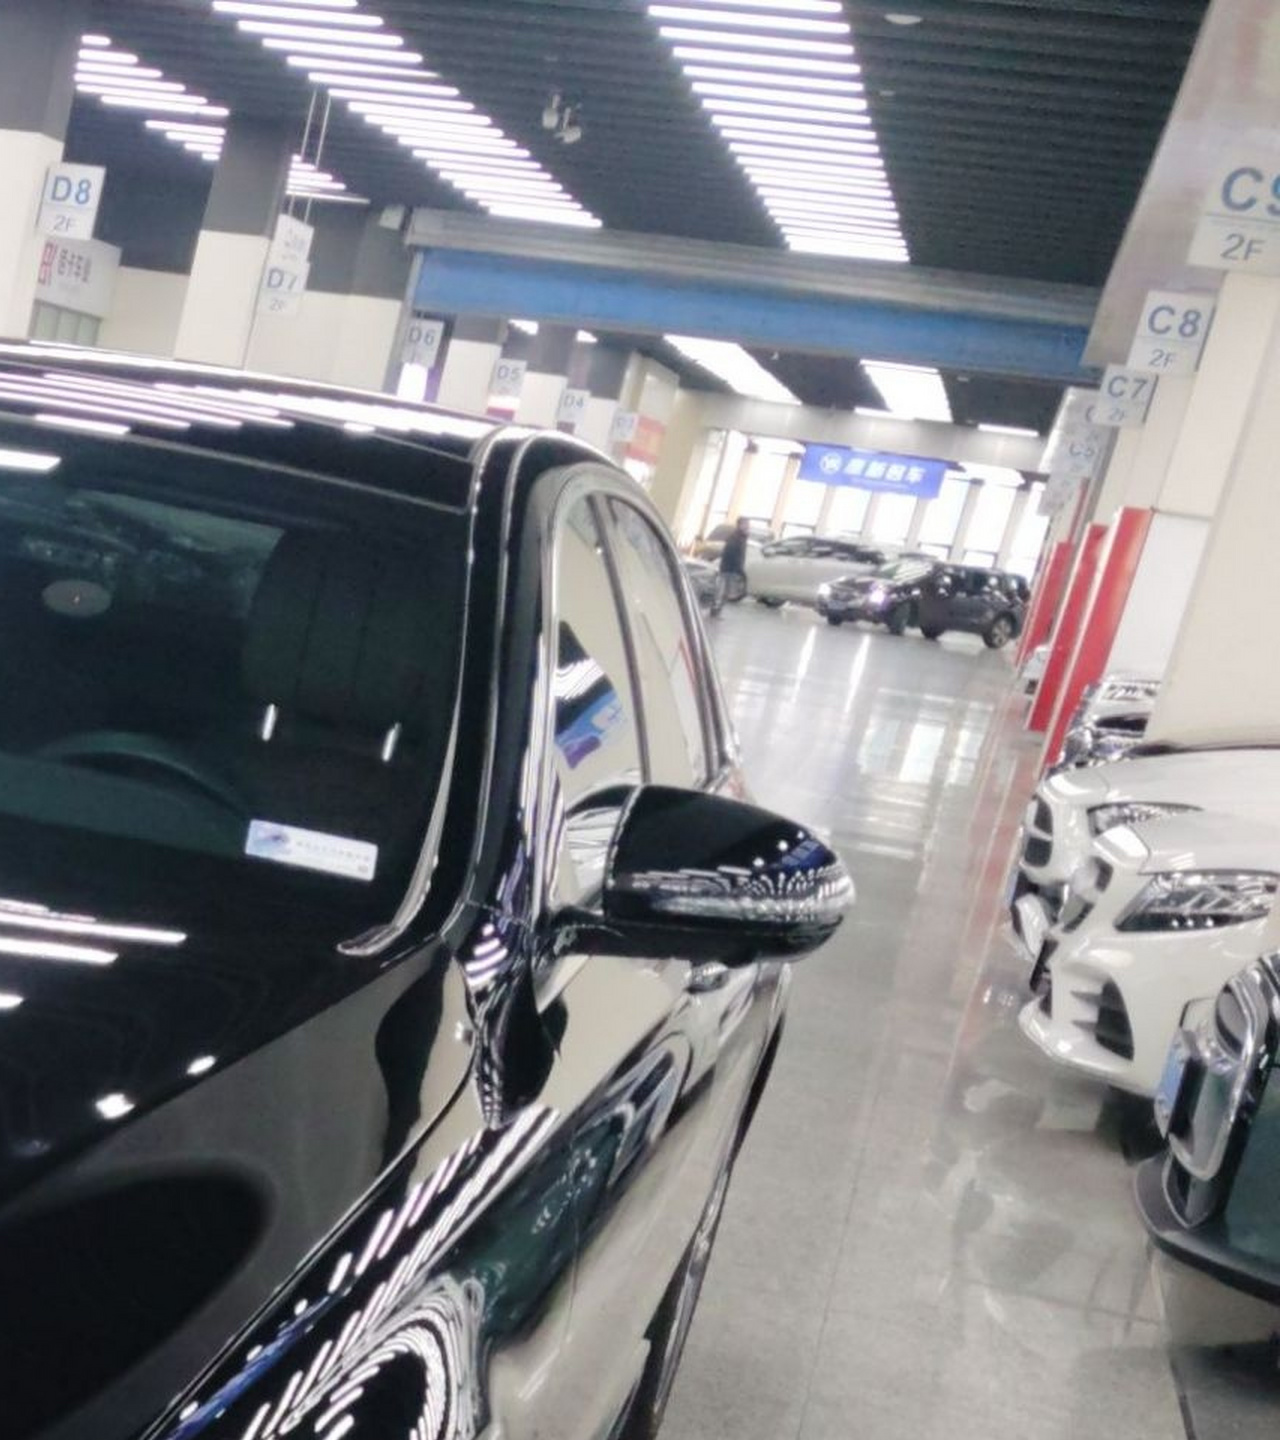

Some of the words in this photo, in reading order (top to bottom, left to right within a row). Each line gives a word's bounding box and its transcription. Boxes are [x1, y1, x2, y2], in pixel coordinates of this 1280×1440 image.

[50, 175, 92, 205] D8
[53, 215, 77, 233] 2F
[1220, 232, 1267, 261] 2F
[266, 267, 298, 291] D7
[1147, 304, 1202, 338] C8
[408, 325, 436, 346] D6
[1148, 348, 1178, 369] 2F
[497, 364, 521, 380] D5
[1107, 374, 1147, 399] C7
